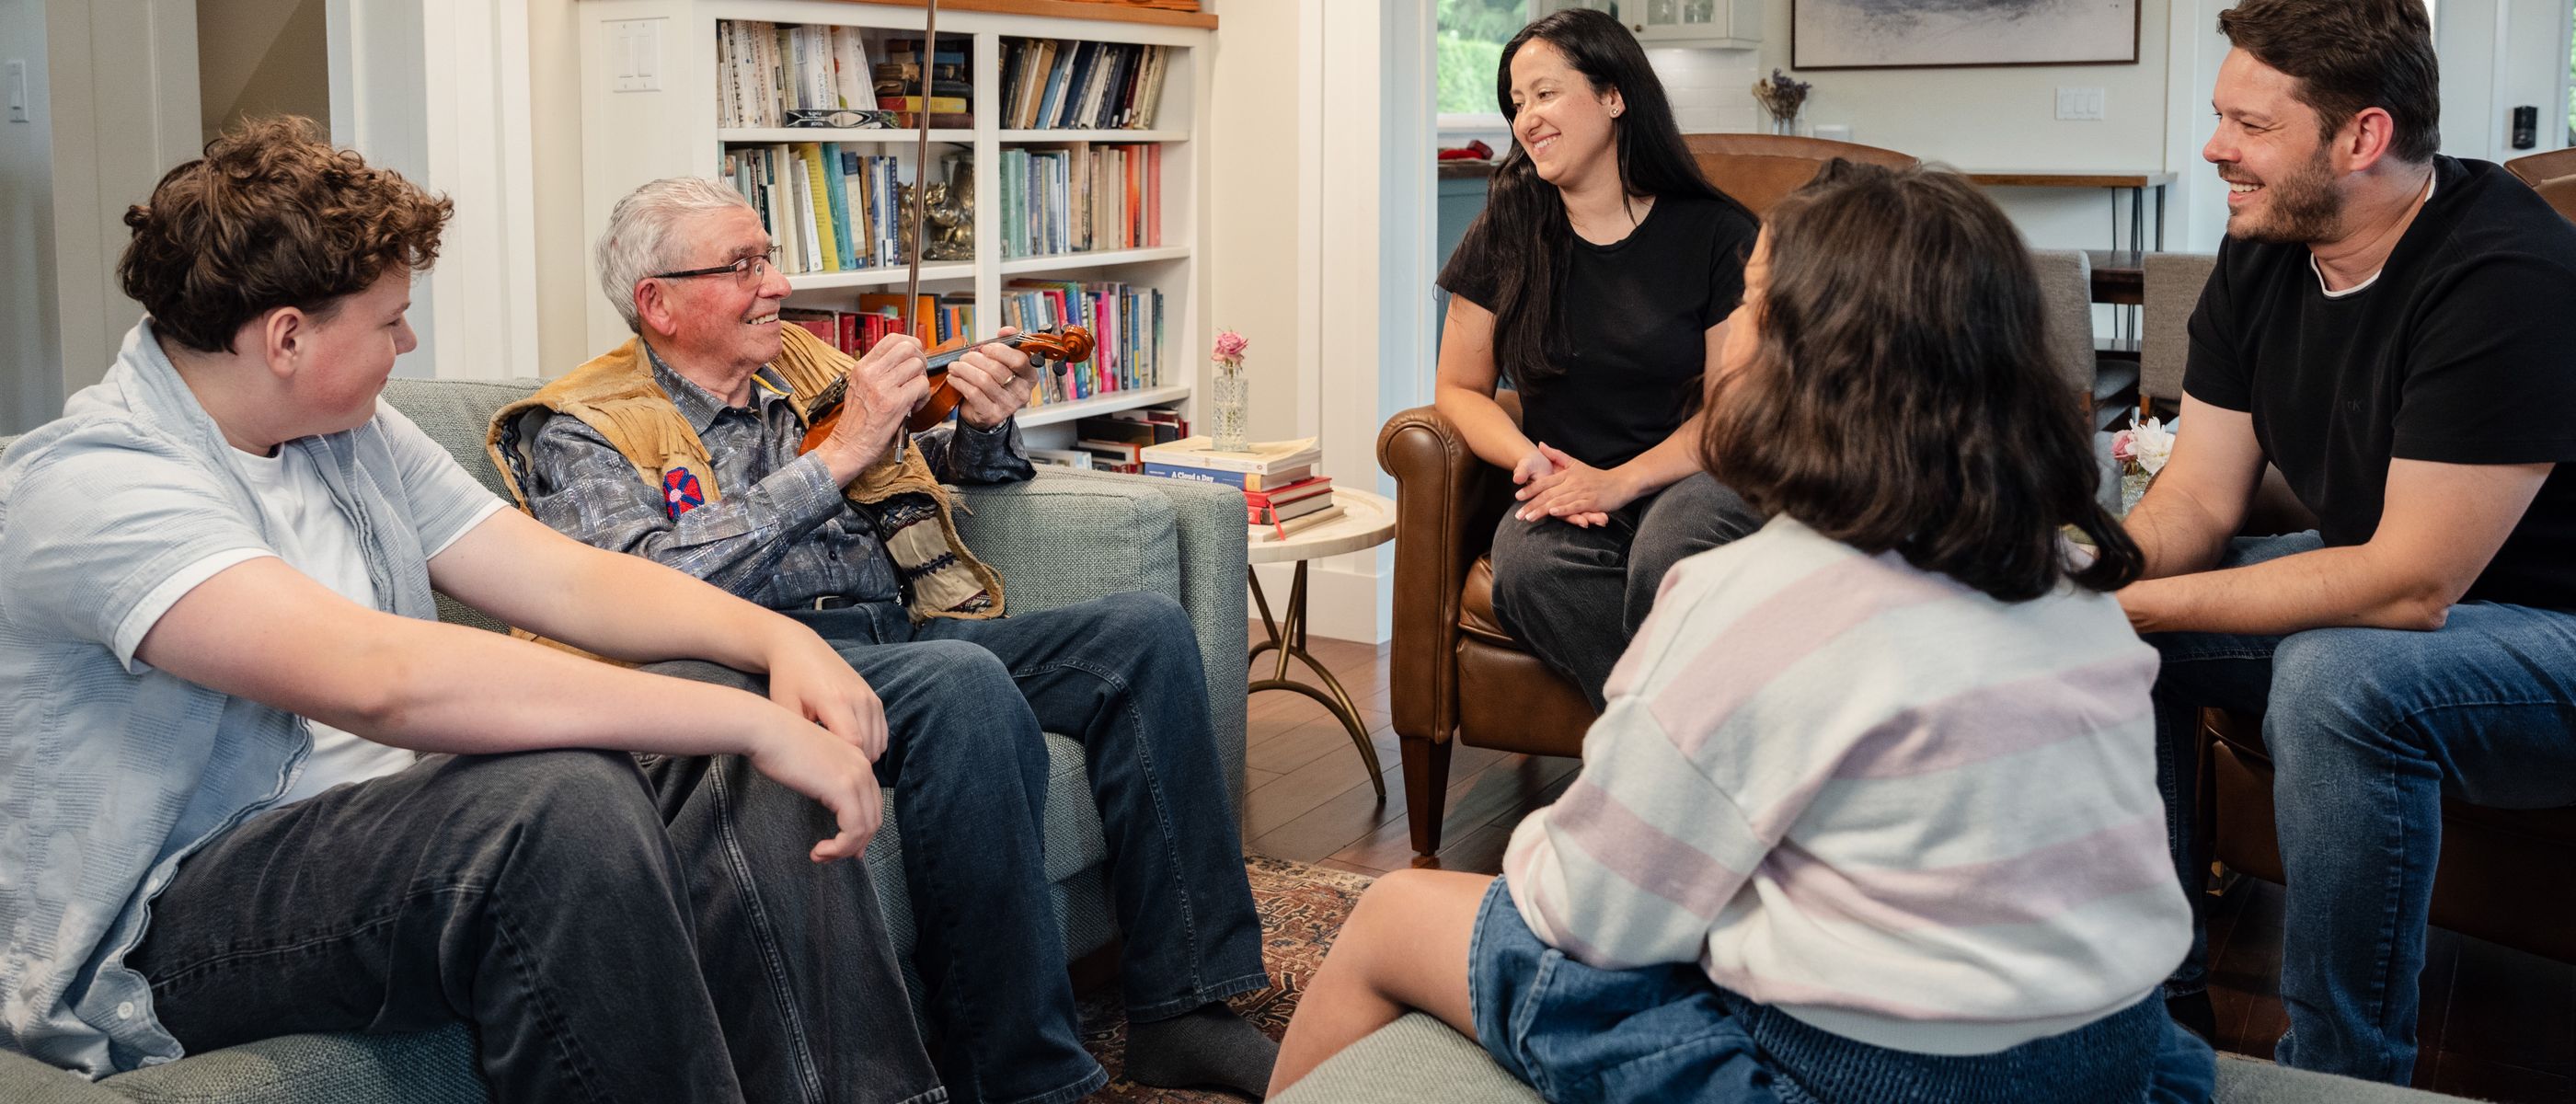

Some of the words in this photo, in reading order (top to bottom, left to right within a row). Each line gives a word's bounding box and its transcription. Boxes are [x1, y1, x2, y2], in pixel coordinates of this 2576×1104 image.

[731, 53, 744, 123] WENDELL
[1171, 471, 1177, 479] A
[1178, 471, 1196, 481] Cloud
[1202, 474, 1214, 483] Day
